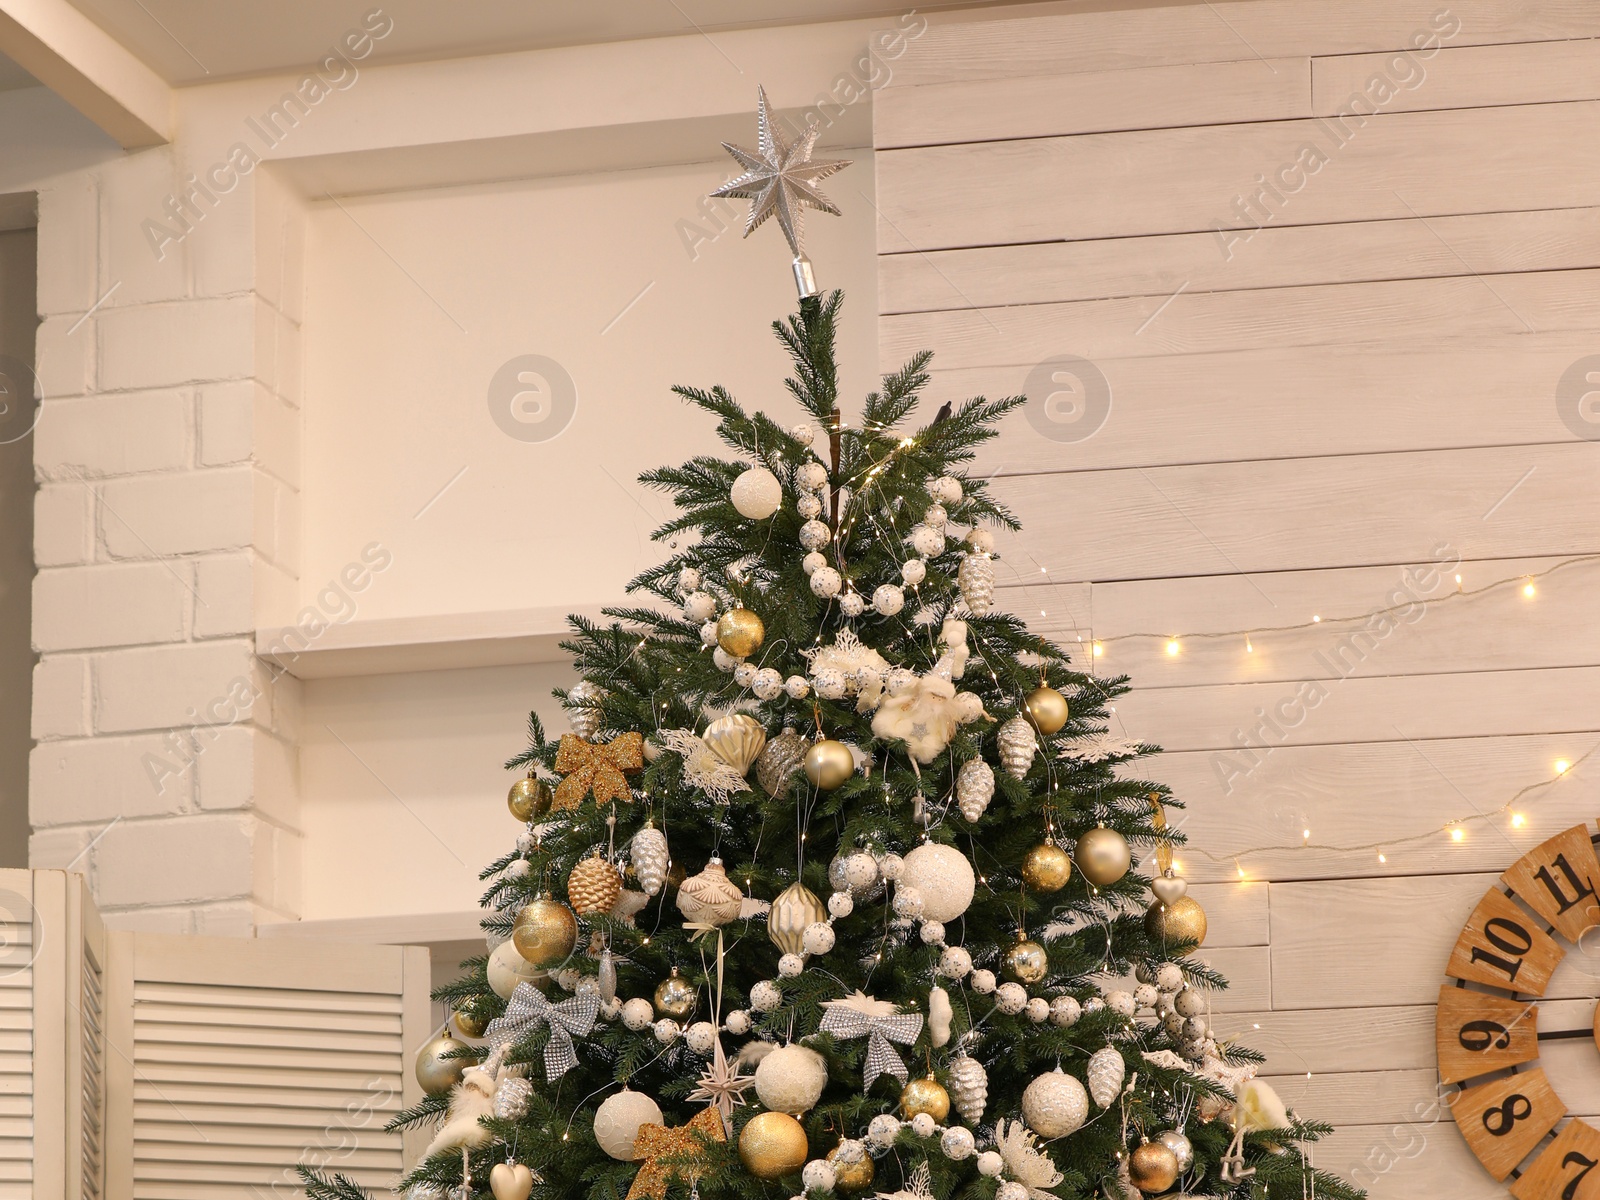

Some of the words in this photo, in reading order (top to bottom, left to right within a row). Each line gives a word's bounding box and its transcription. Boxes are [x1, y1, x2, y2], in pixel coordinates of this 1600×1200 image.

[1533, 853, 1593, 915] 11
[1470, 917, 1532, 983] 10
[1459, 1020, 1511, 1052] 9
[1482, 1094, 1532, 1137] 8
